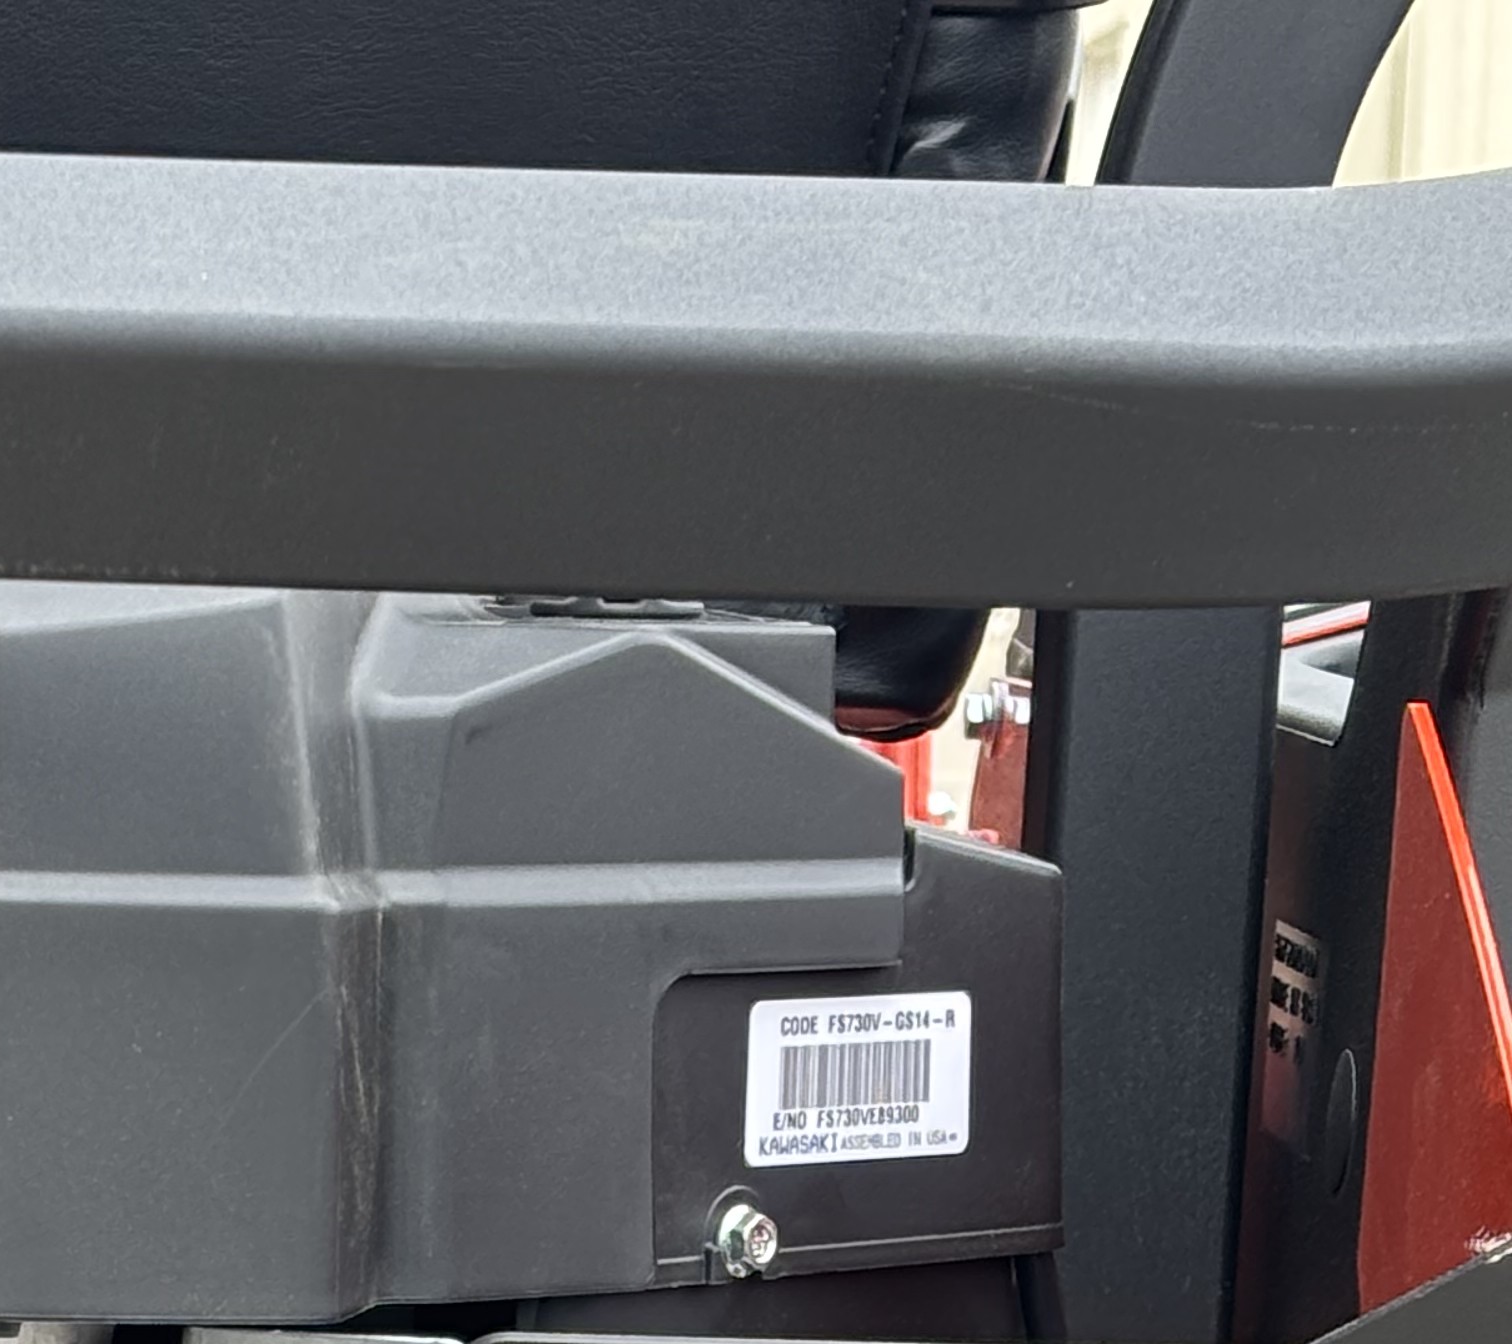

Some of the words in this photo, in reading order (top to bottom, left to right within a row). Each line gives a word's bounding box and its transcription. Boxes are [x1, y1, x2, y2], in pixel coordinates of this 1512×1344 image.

[780, 1015, 818, 1037] CODE
[772, 1109, 807, 1131] E/NO
[758, 1132, 838, 1157] KAWASAKI
[908, 1131, 922, 1147] IN
